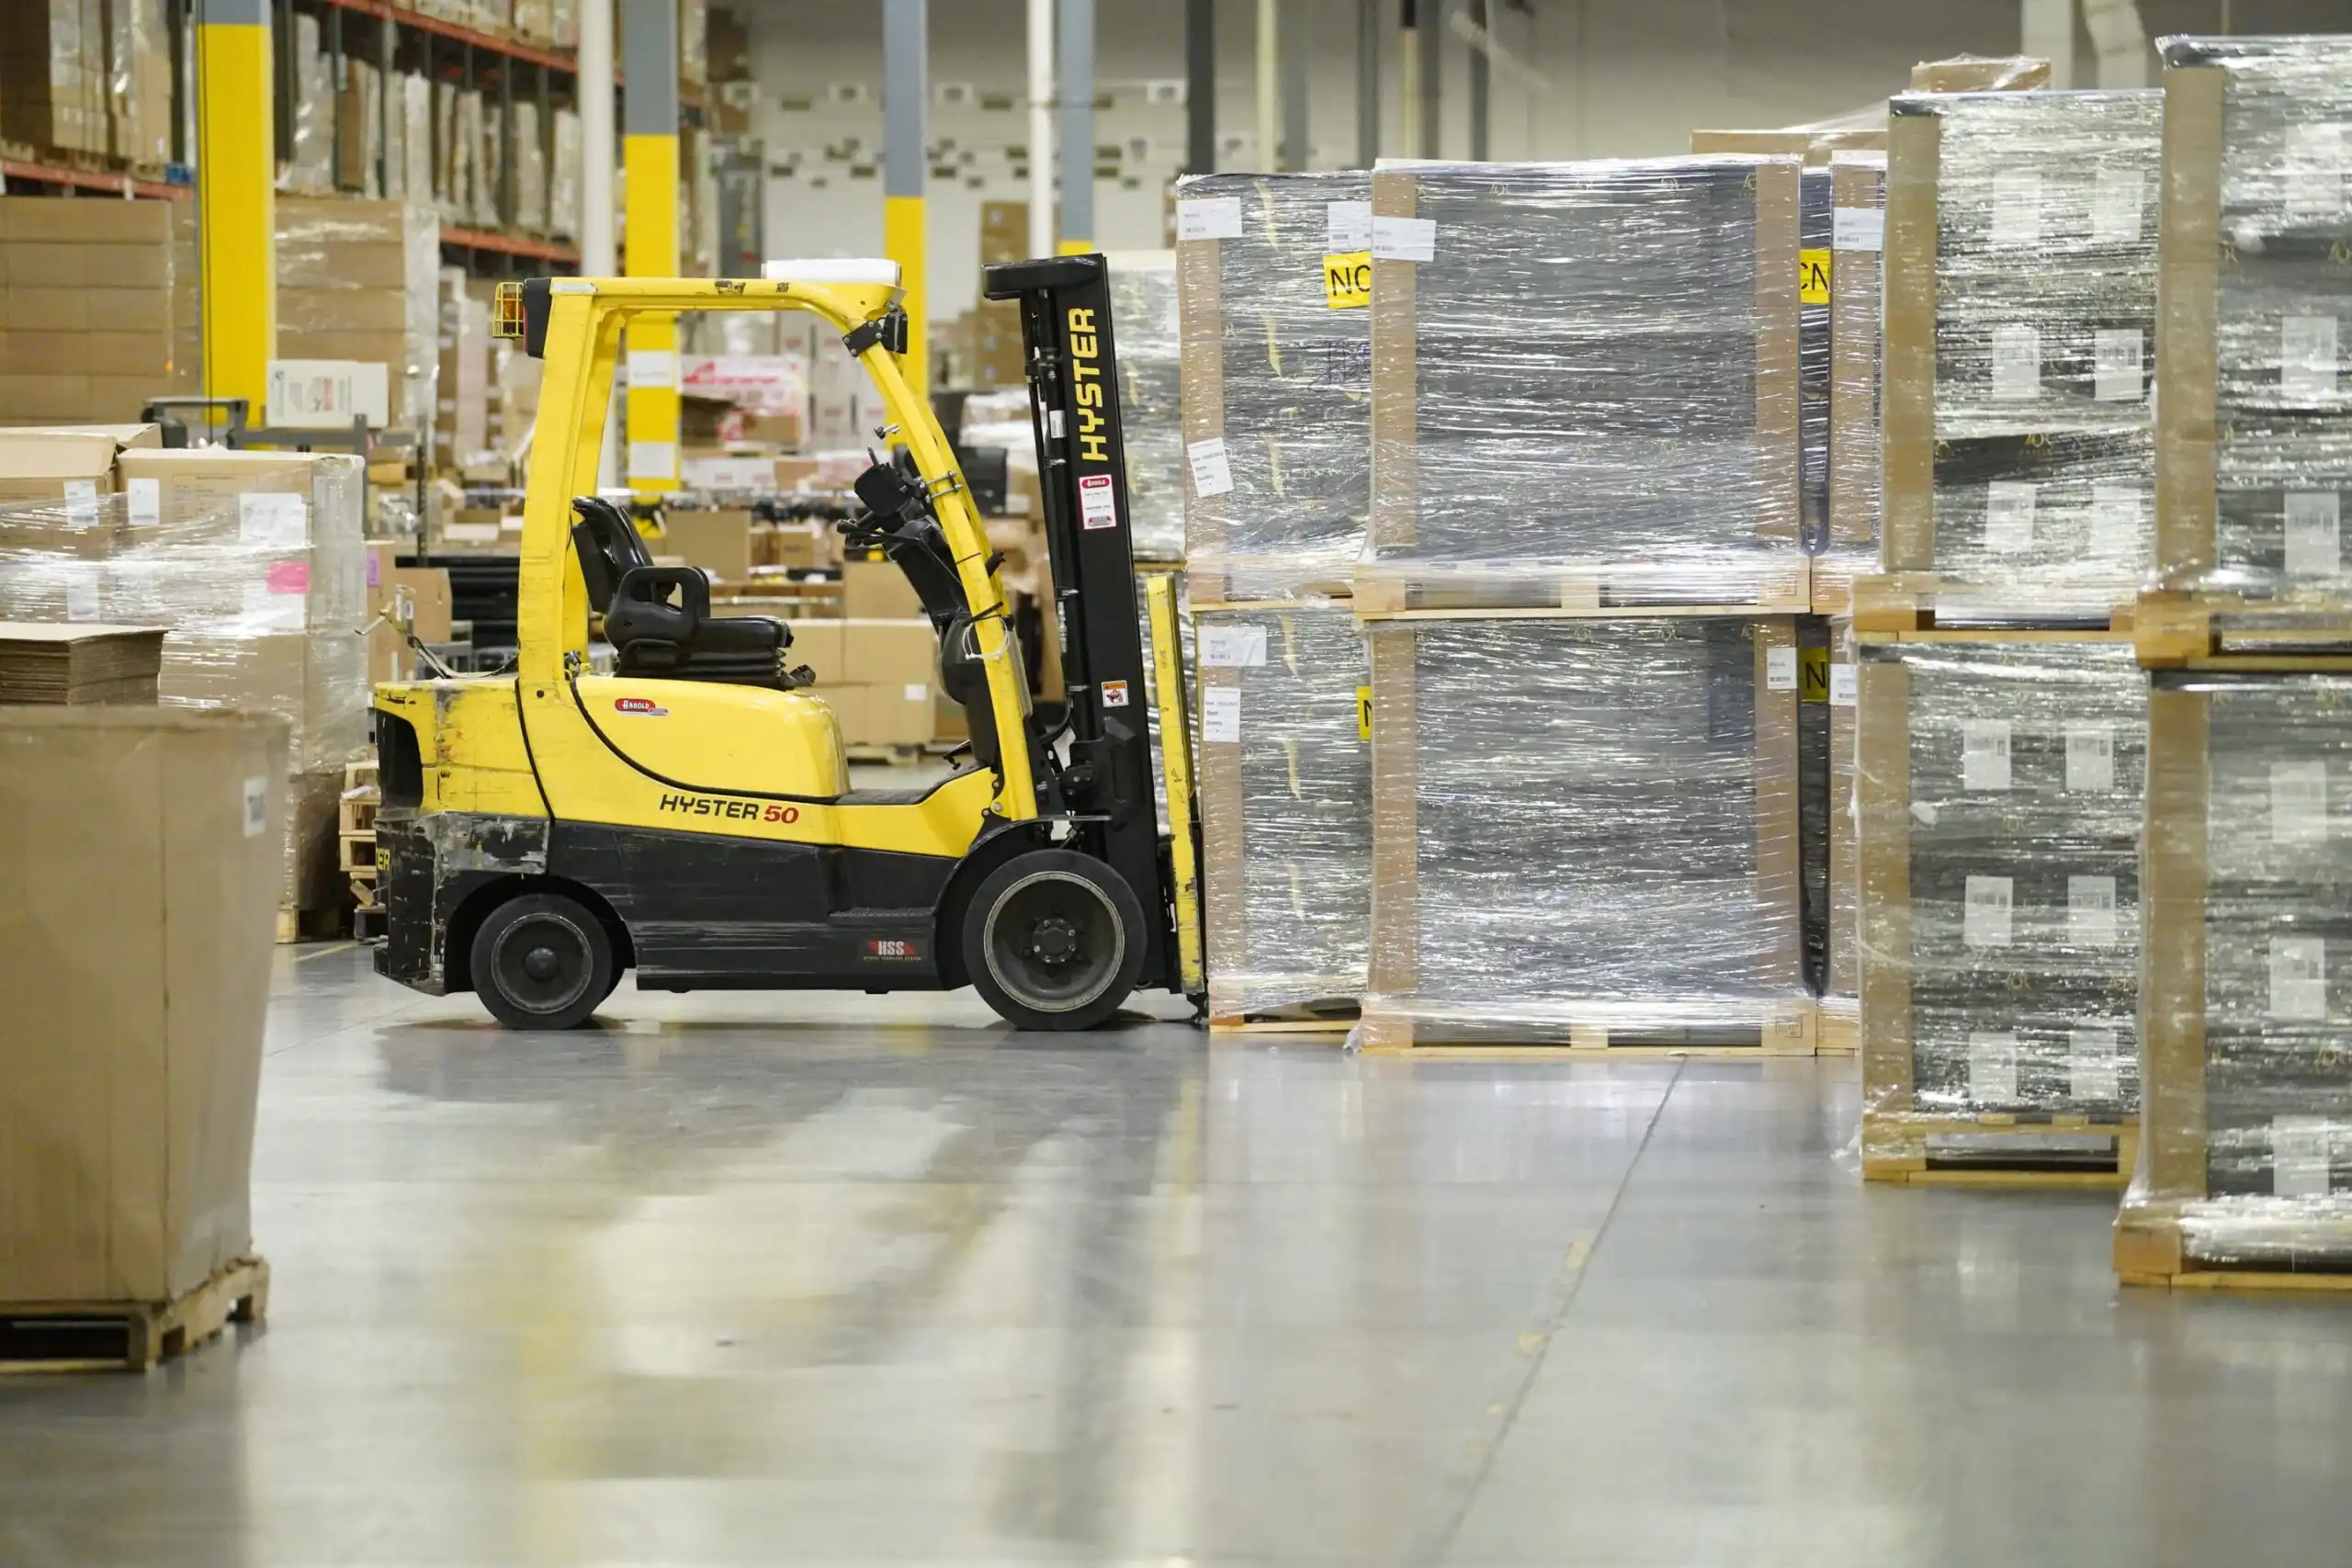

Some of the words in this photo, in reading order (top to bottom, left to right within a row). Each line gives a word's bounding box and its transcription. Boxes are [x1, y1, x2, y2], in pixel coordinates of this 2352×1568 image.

[1069, 308, 1108, 461] HYSTER
[1806, 660, 1826, 691] N
[660, 794, 760, 820] HYSTER
[763, 805, 799, 824] 50
[377, 849, 390, 871] ER
[878, 941, 905, 955] HSS
